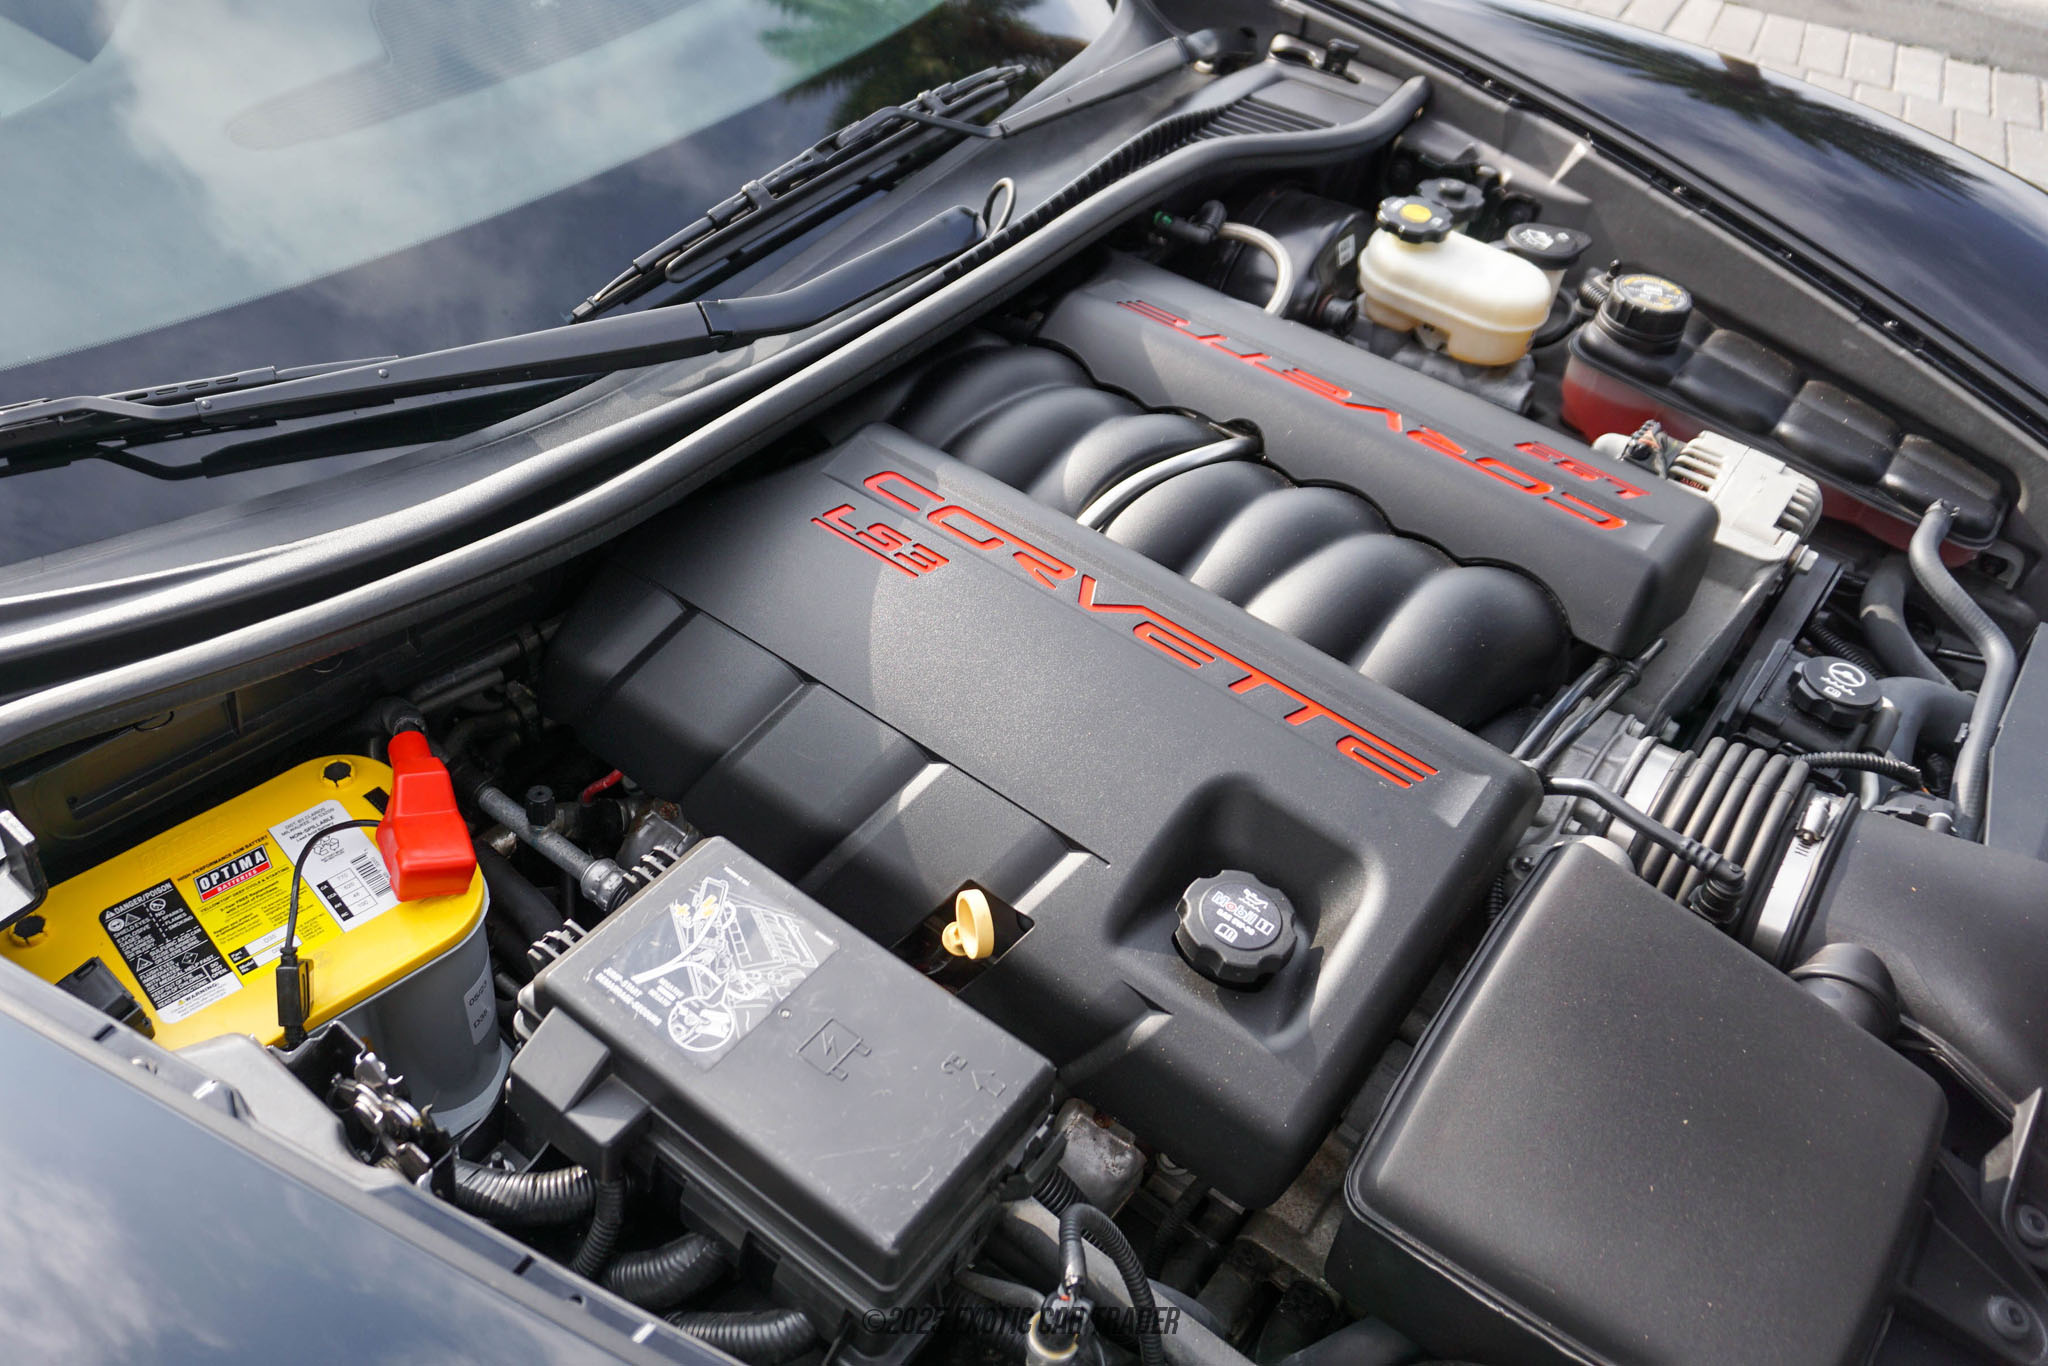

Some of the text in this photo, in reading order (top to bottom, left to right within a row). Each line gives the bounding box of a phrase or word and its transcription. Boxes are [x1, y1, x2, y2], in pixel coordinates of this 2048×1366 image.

[1116, 300, 1627, 530] CORVETTE
[1513, 441, 1651, 499] LS3
[810, 502, 950, 578] LS3
[863, 470, 1440, 789] CORVETTE
[243, 833, 268, 848] BATTERY
[196, 849, 267, 891] OPTIMA
[215, 868, 259, 892] BATTERIES
[113, 881, 173, 914] DANGER/POISON
[1211, 890, 1258, 926] Mobil
[154, 909, 167, 918] NO
[160, 906, 184, 921] SPARKS
[163, 911, 188, 926] FLAMES
[166, 914, 194, 930] SMOKING
[111, 923, 136, 938] SHIELD
[115, 923, 152, 944] EXPLOSIVE
[148, 939, 178, 957] SULFURIC
[157, 969, 185, 986] MEDICAL
[183, 961, 201, 973] HELP
